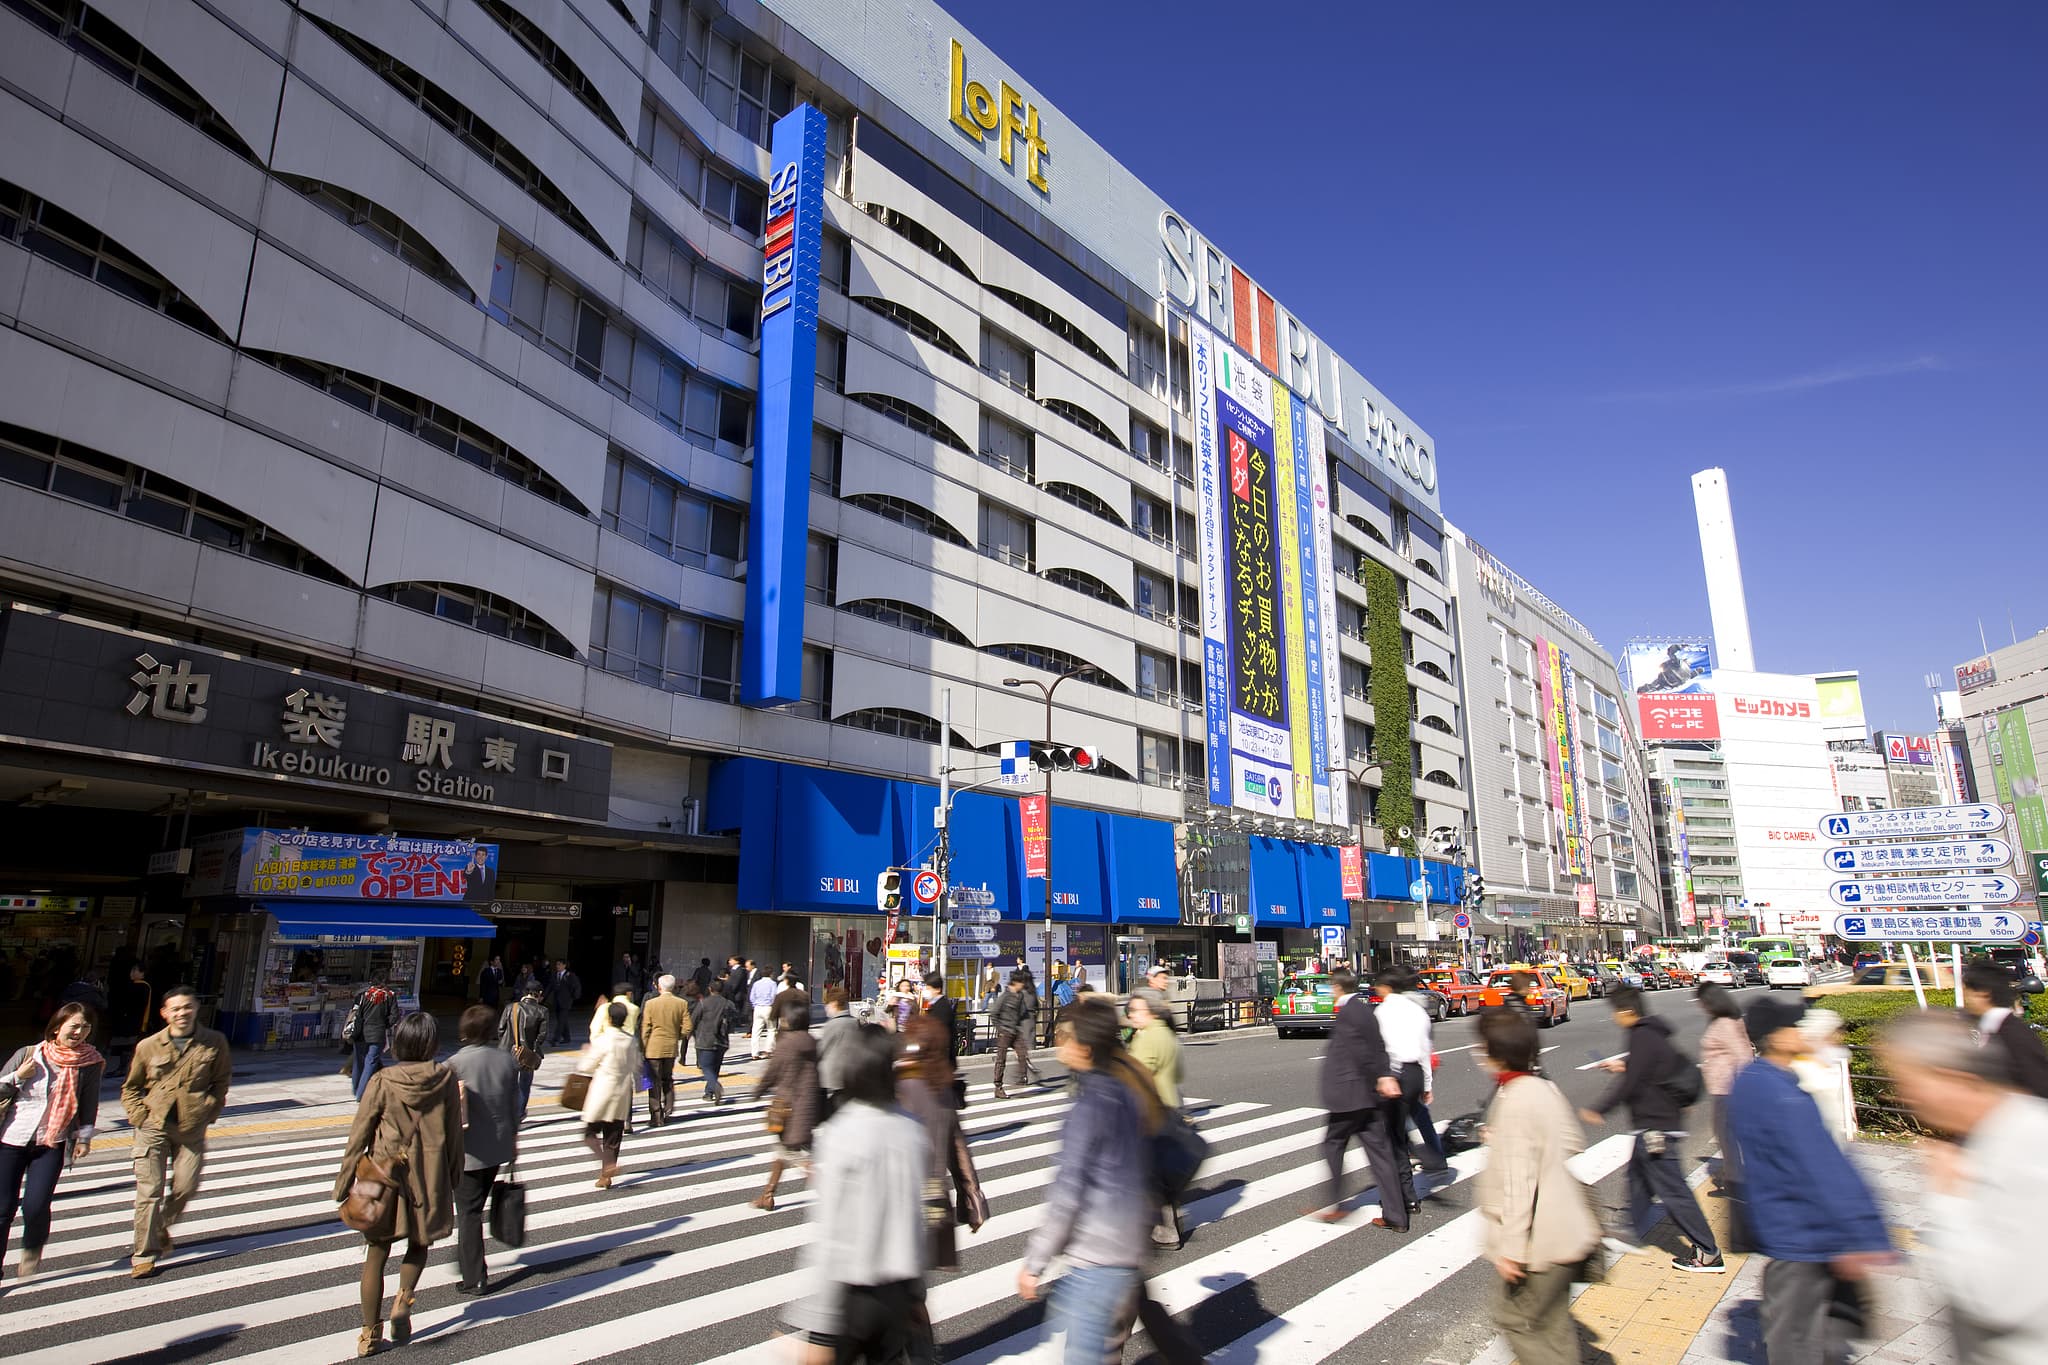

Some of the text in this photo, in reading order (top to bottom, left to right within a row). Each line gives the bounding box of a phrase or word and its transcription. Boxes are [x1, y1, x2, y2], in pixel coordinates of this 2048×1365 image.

[761, 161, 798, 323] SEIBU
[1159, 210, 1348, 440] SEIBU
[1234, 360, 1263, 404] 池袋
[1363, 396, 1435, 491] PARCO
[1232, 435, 1247, 493] タダ
[1669, 708, 1702, 718] ドコモ
[1734, 697, 1810, 718] ビックカメラ
[1686, 720, 1704, 729] PC
[253, 741, 495, 802] Ikebukuro Station
[1001, 774, 1028, 784] 時差式
[1768, 831, 1816, 841] BIC CAMERA
[1861, 845, 1967, 860] 池袋職業安定所
[820, 877, 859, 893] SEIBU
[1864, 881, 1976, 895] 労働相談情報センター
[1053, 892, 1079, 905] SEIBU
[1138, 897, 1161, 909] SEIBU
[1270, 904, 1287, 915] SEIBU
[1871, 916, 1982, 928] 豊島区総合運動場
[1324, 928, 1338, 944] P
